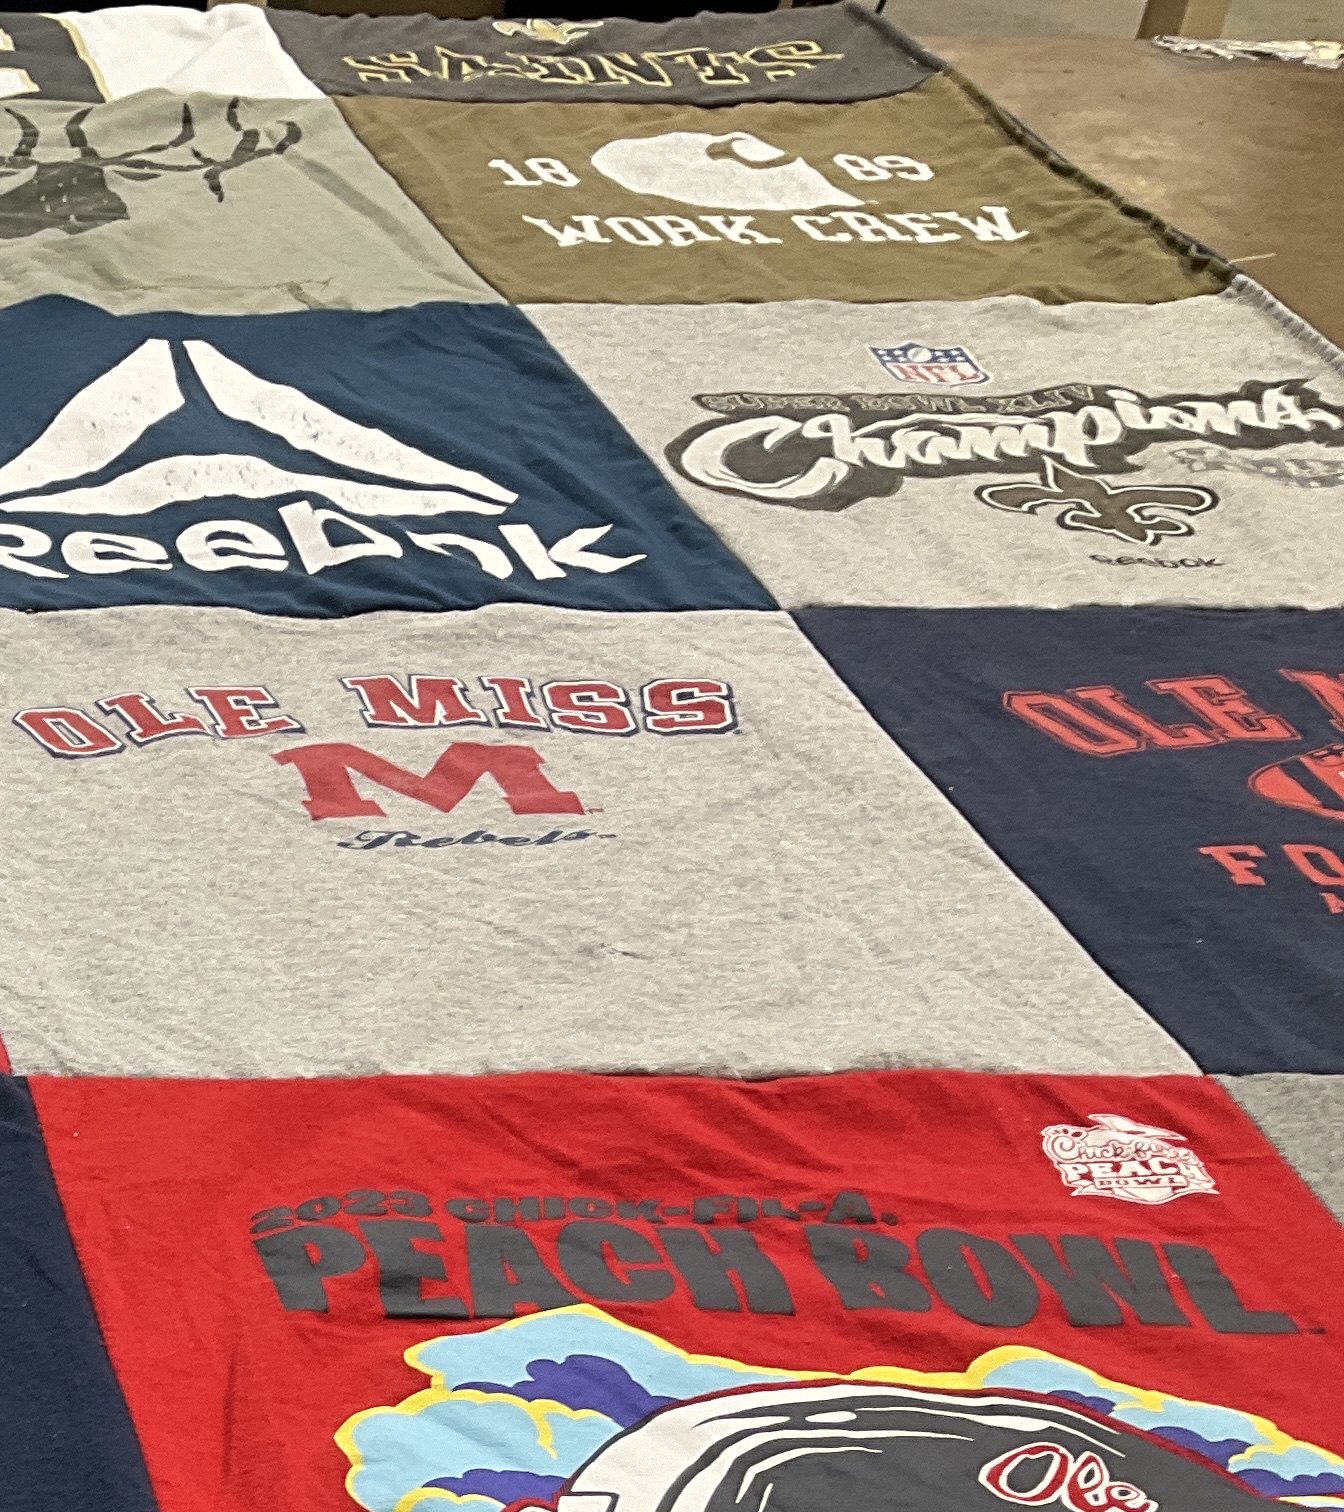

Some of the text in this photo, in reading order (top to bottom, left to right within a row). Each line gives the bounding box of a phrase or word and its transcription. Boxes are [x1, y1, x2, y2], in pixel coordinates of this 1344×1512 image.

[488, 153, 935, 188] 18 89
[522, 206, 1031, 248] WORK CREW
[896, 363, 980, 384] NFL
[682, 386, 1343, 499] Champions
[13, 673, 738, 761] OLE MISS
[1002, 673, 1303, 758] OLE
[336, 828, 598, 851] Rebels
[1059, 1157, 1218, 1188] PEACH
[249, 1188, 433, 1235] 2023
[252, 1218, 1301, 1334] PEACH BOWL
